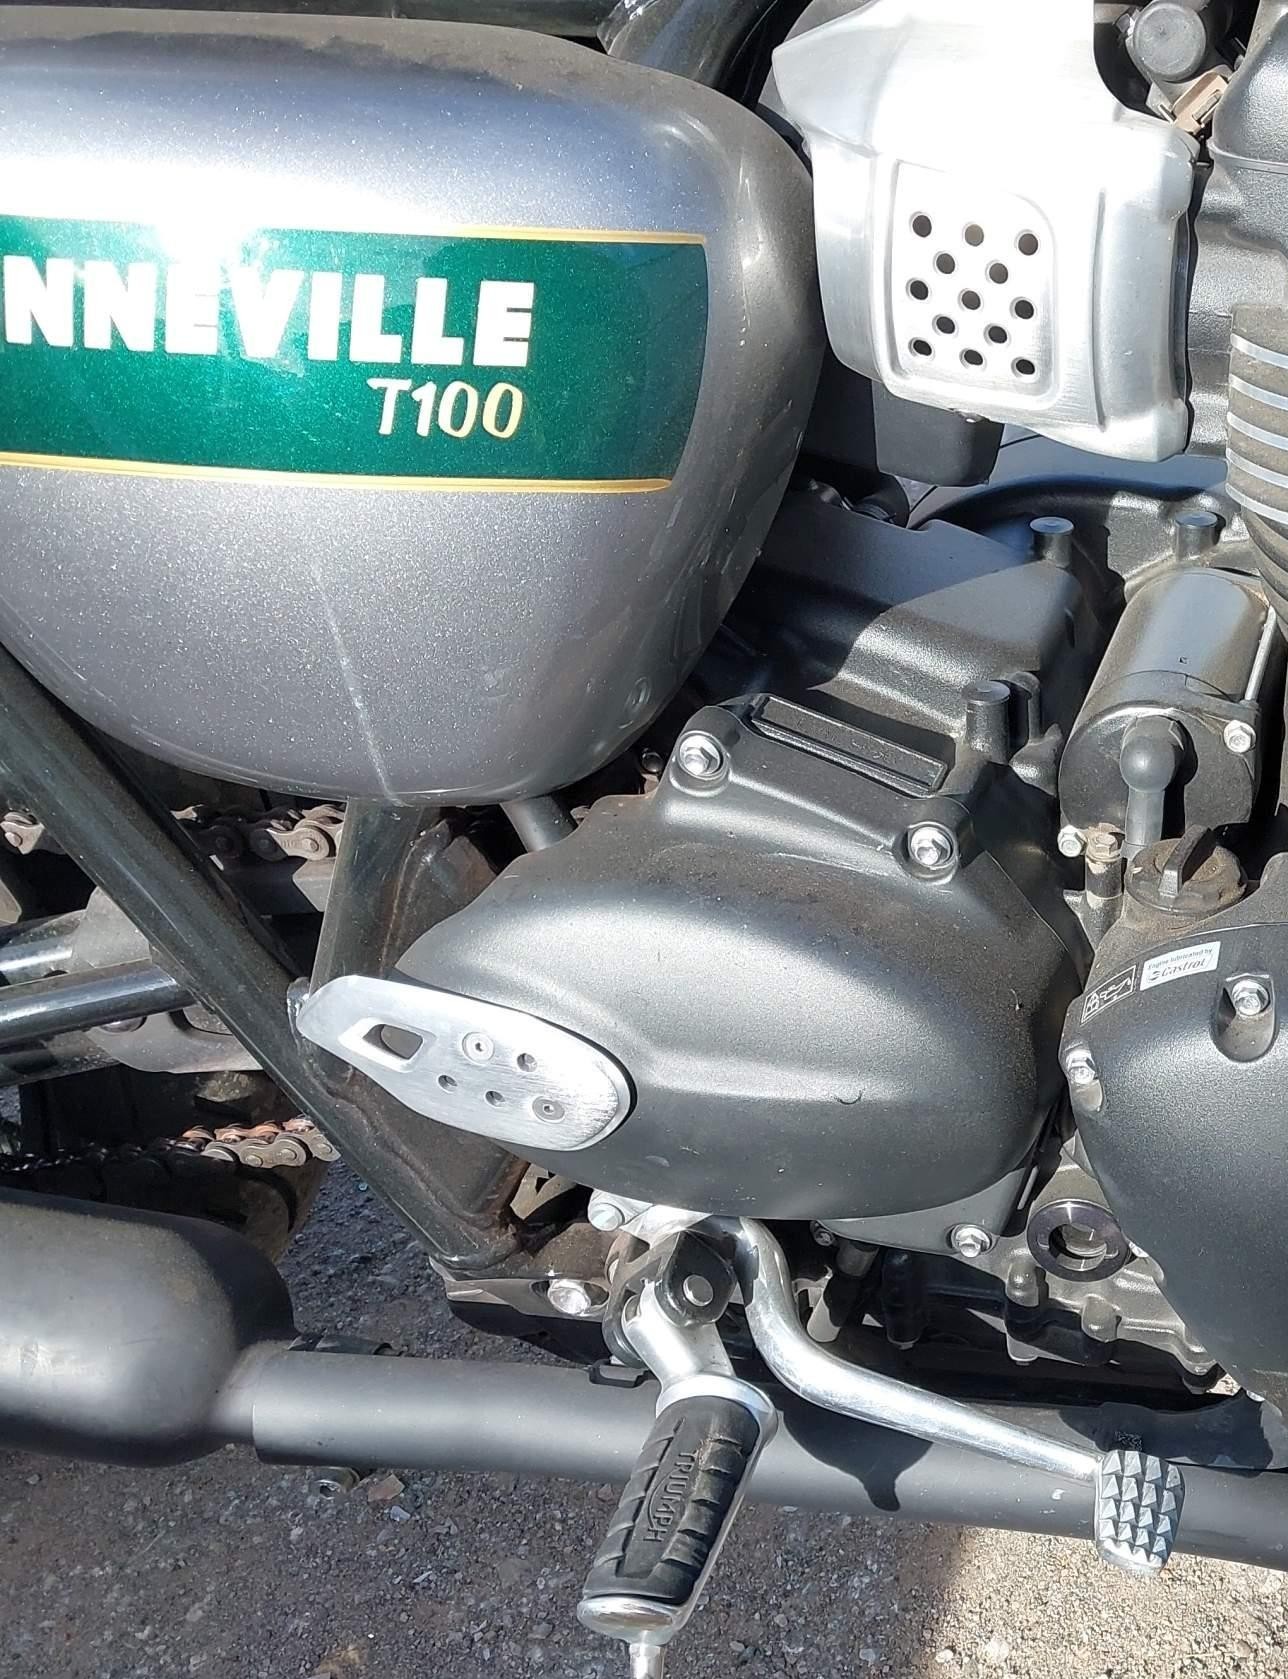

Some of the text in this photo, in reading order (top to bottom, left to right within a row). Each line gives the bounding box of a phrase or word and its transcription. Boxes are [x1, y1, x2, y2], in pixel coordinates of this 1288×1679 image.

[3, 254, 535, 368] NNEVILLE
[366, 377, 524, 440] T100
[643, 1450, 699, 1542] TRIUMPH
